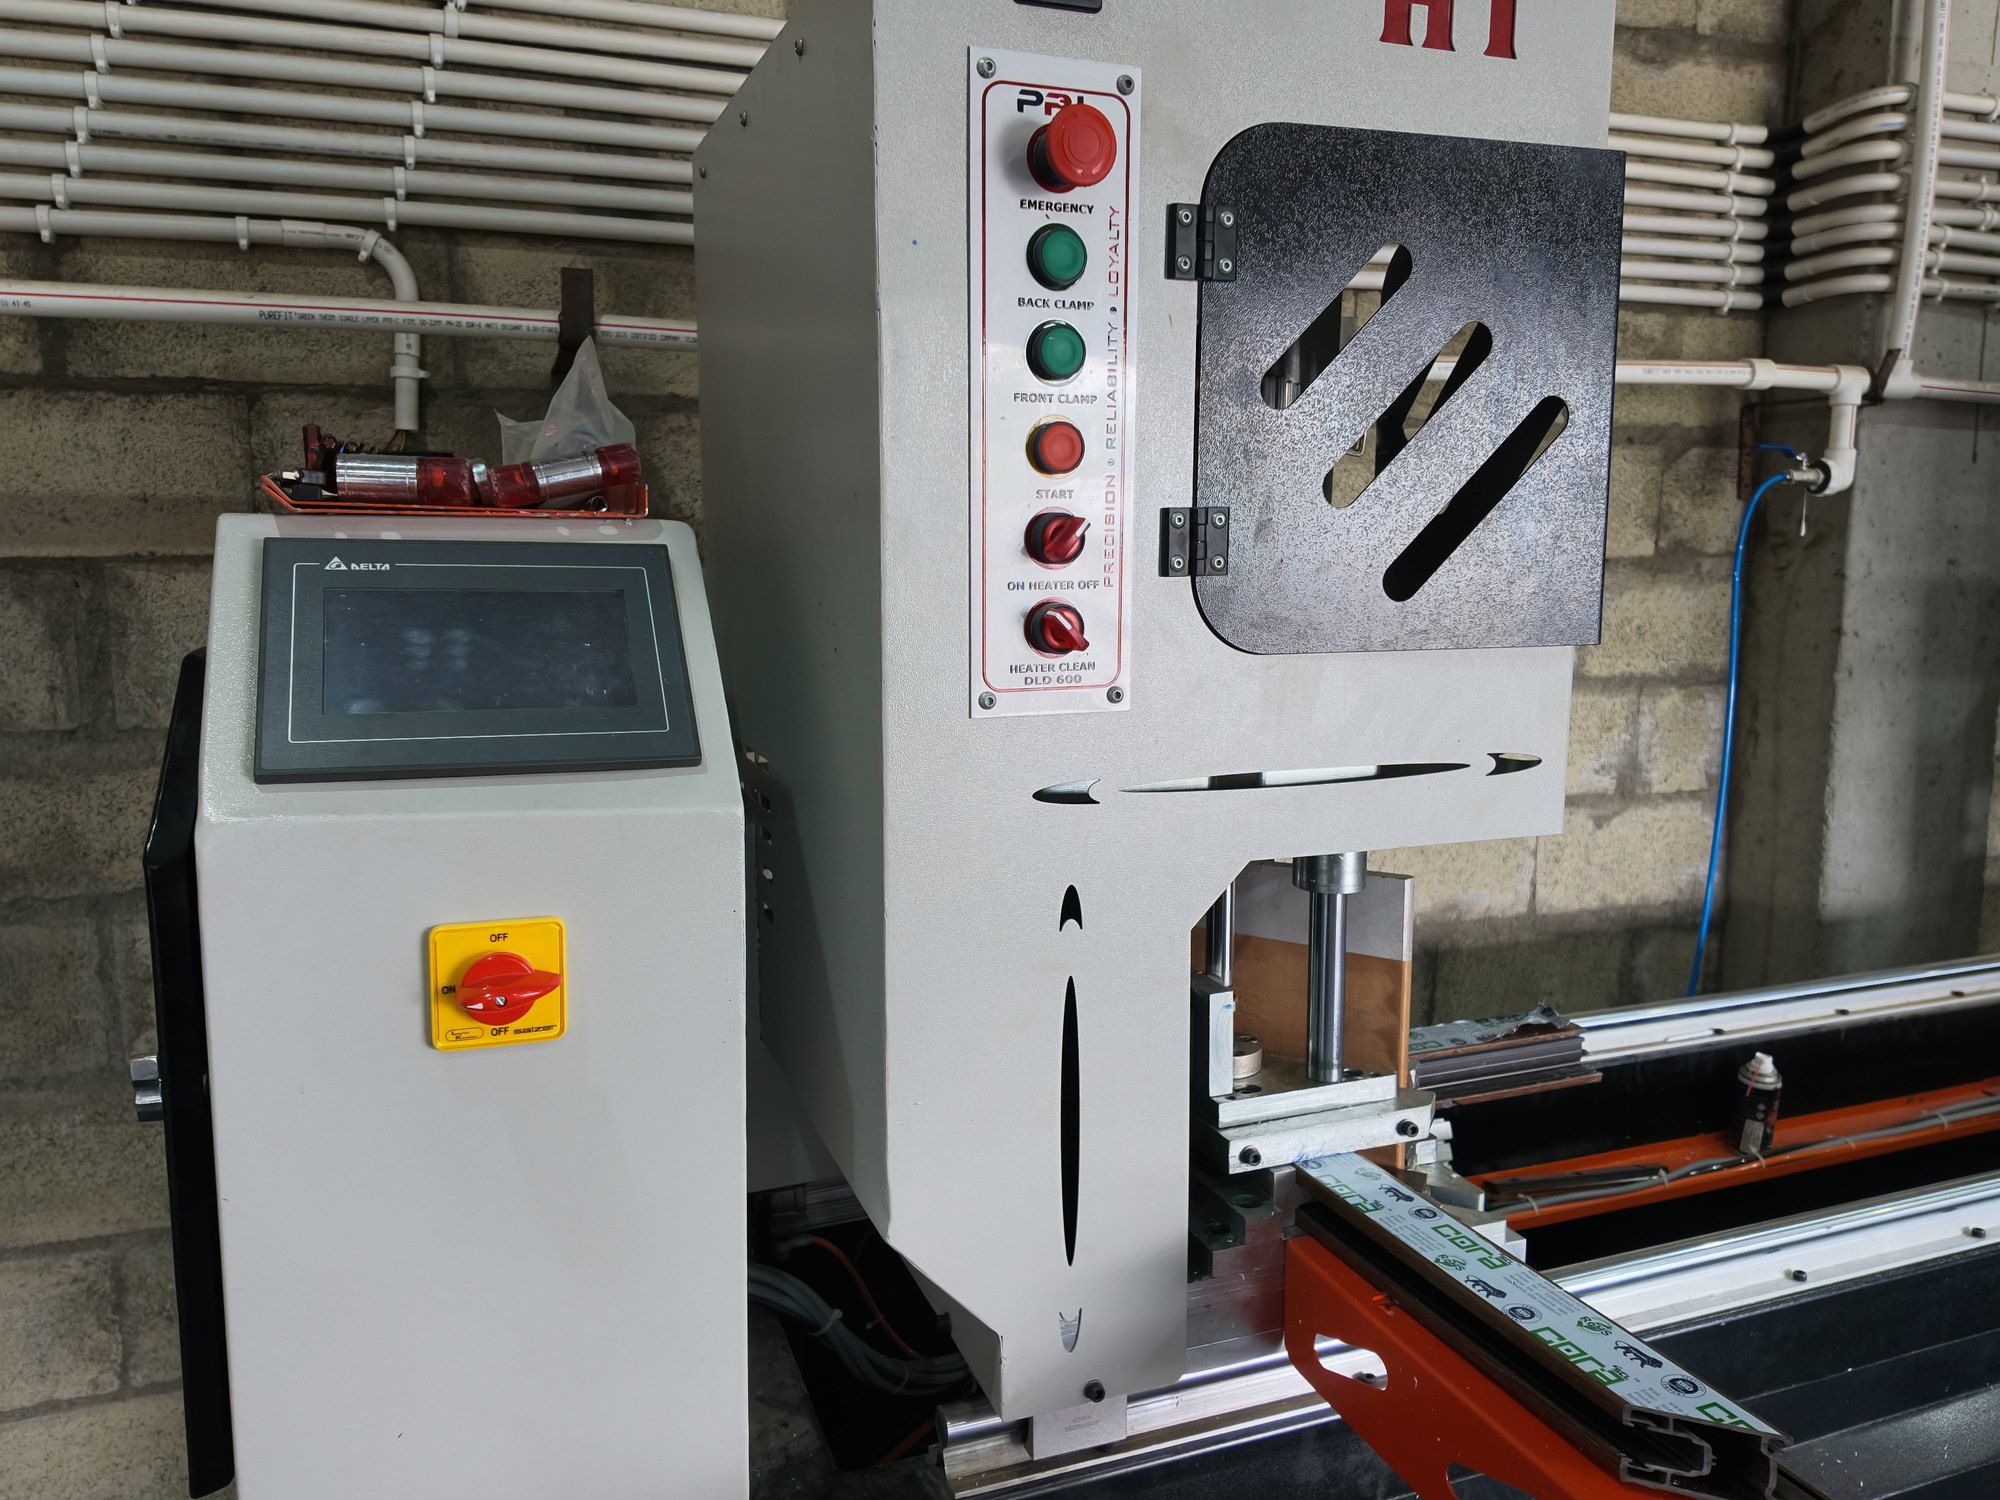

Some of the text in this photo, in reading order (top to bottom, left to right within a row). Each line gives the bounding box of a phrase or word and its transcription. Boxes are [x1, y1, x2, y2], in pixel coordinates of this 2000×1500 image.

[1019, 199, 1094, 216] EMERGENCY
[1017, 297, 1095, 311] BACK CLAMP
[1013, 392, 1098, 405] FRONT CLAMP
[1103, 205, 1121, 588] PRECISION RELIABILITY LOYALTY
[1036, 489, 1075, 500] START
[350, 563, 390, 571] DELTA
[1007, 579, 1100, 591] ON HEATER OFF
[1009, 661, 1096, 674] HEATER CLEAN
[1024, 675, 1052, 685] DLD
[489, 933, 509, 943] OFF
[441, 985, 457, 995] ON
[490, 1026, 510, 1037] OFF
